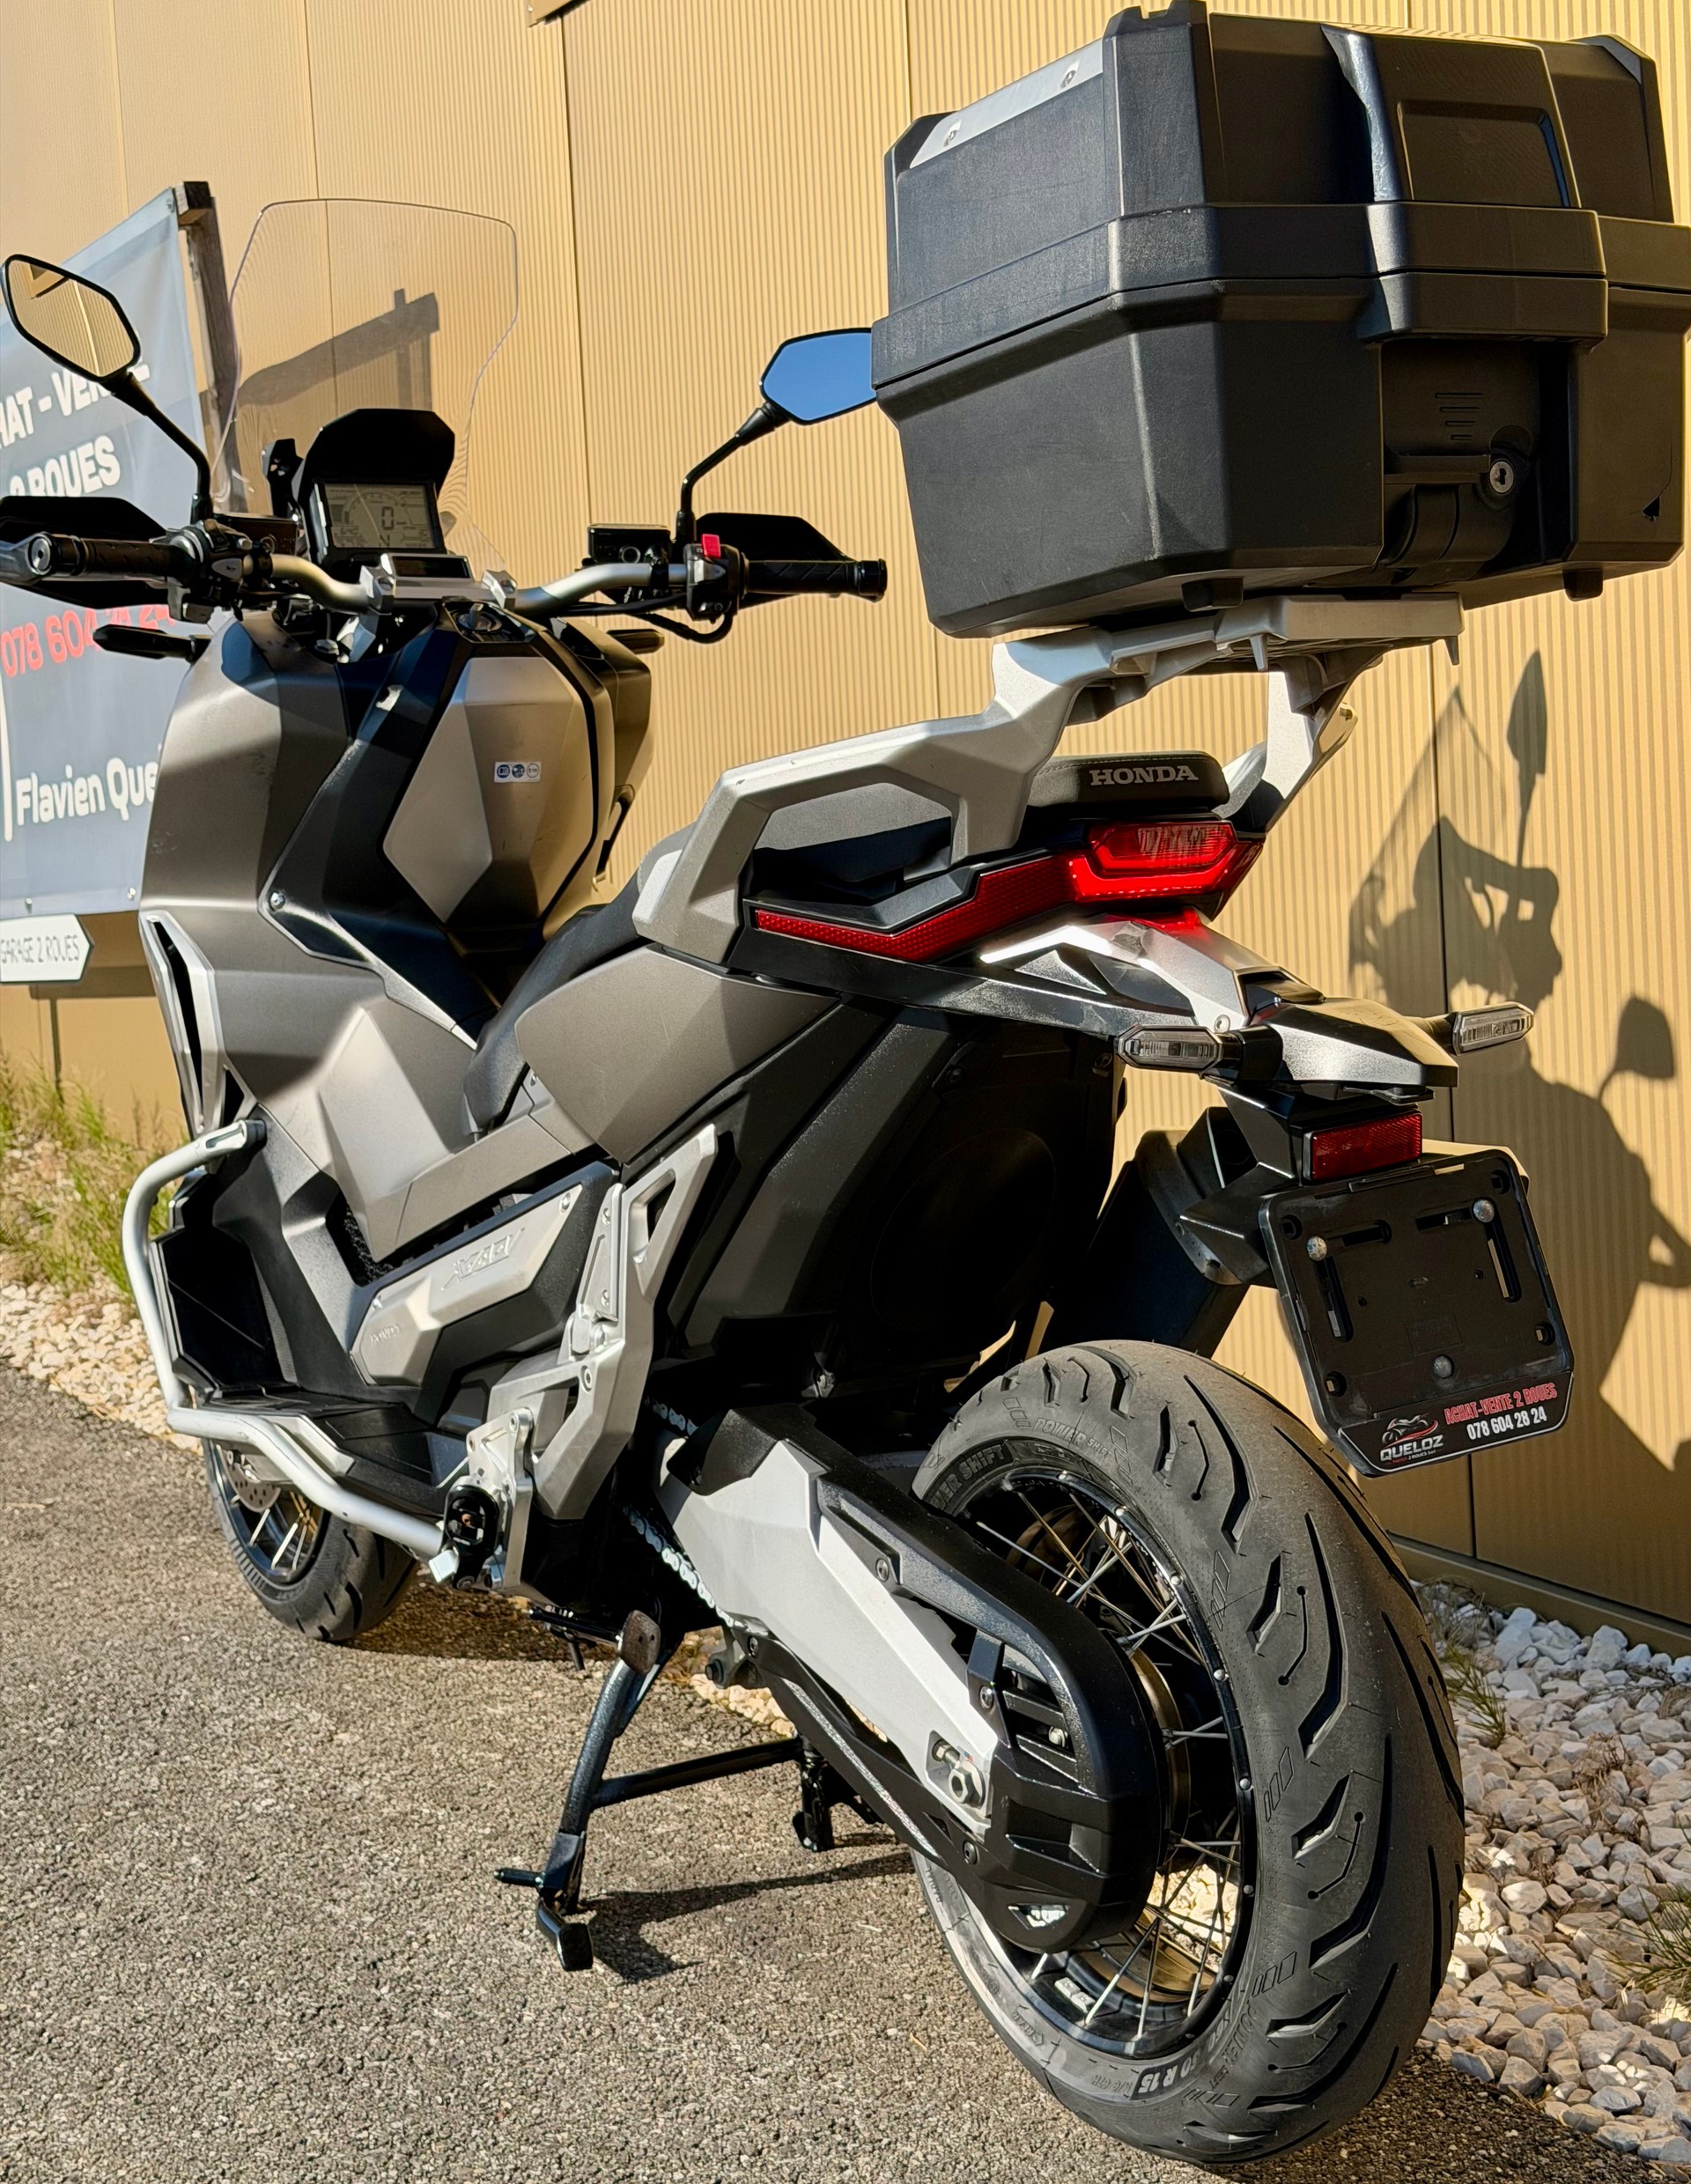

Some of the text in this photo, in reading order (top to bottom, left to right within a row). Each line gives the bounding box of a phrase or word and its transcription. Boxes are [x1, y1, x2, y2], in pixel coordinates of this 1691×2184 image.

[1, 623, 44, 678] 078
[16, 748, 162, 826] Flavien Que
[1089, 764, 1199, 786] HONDA
[36, 936, 44, 963] 2
[45, 934, 80, 963] ROUES
[1444, 1382, 1558, 1425] ACHAT-VENTE 2 ROUES
[1032, 1417, 1087, 1447] POWER
[1466, 1406, 1547, 1441] 078 604 28 24
[1380, 1435, 1444, 1462] QUELOZ
